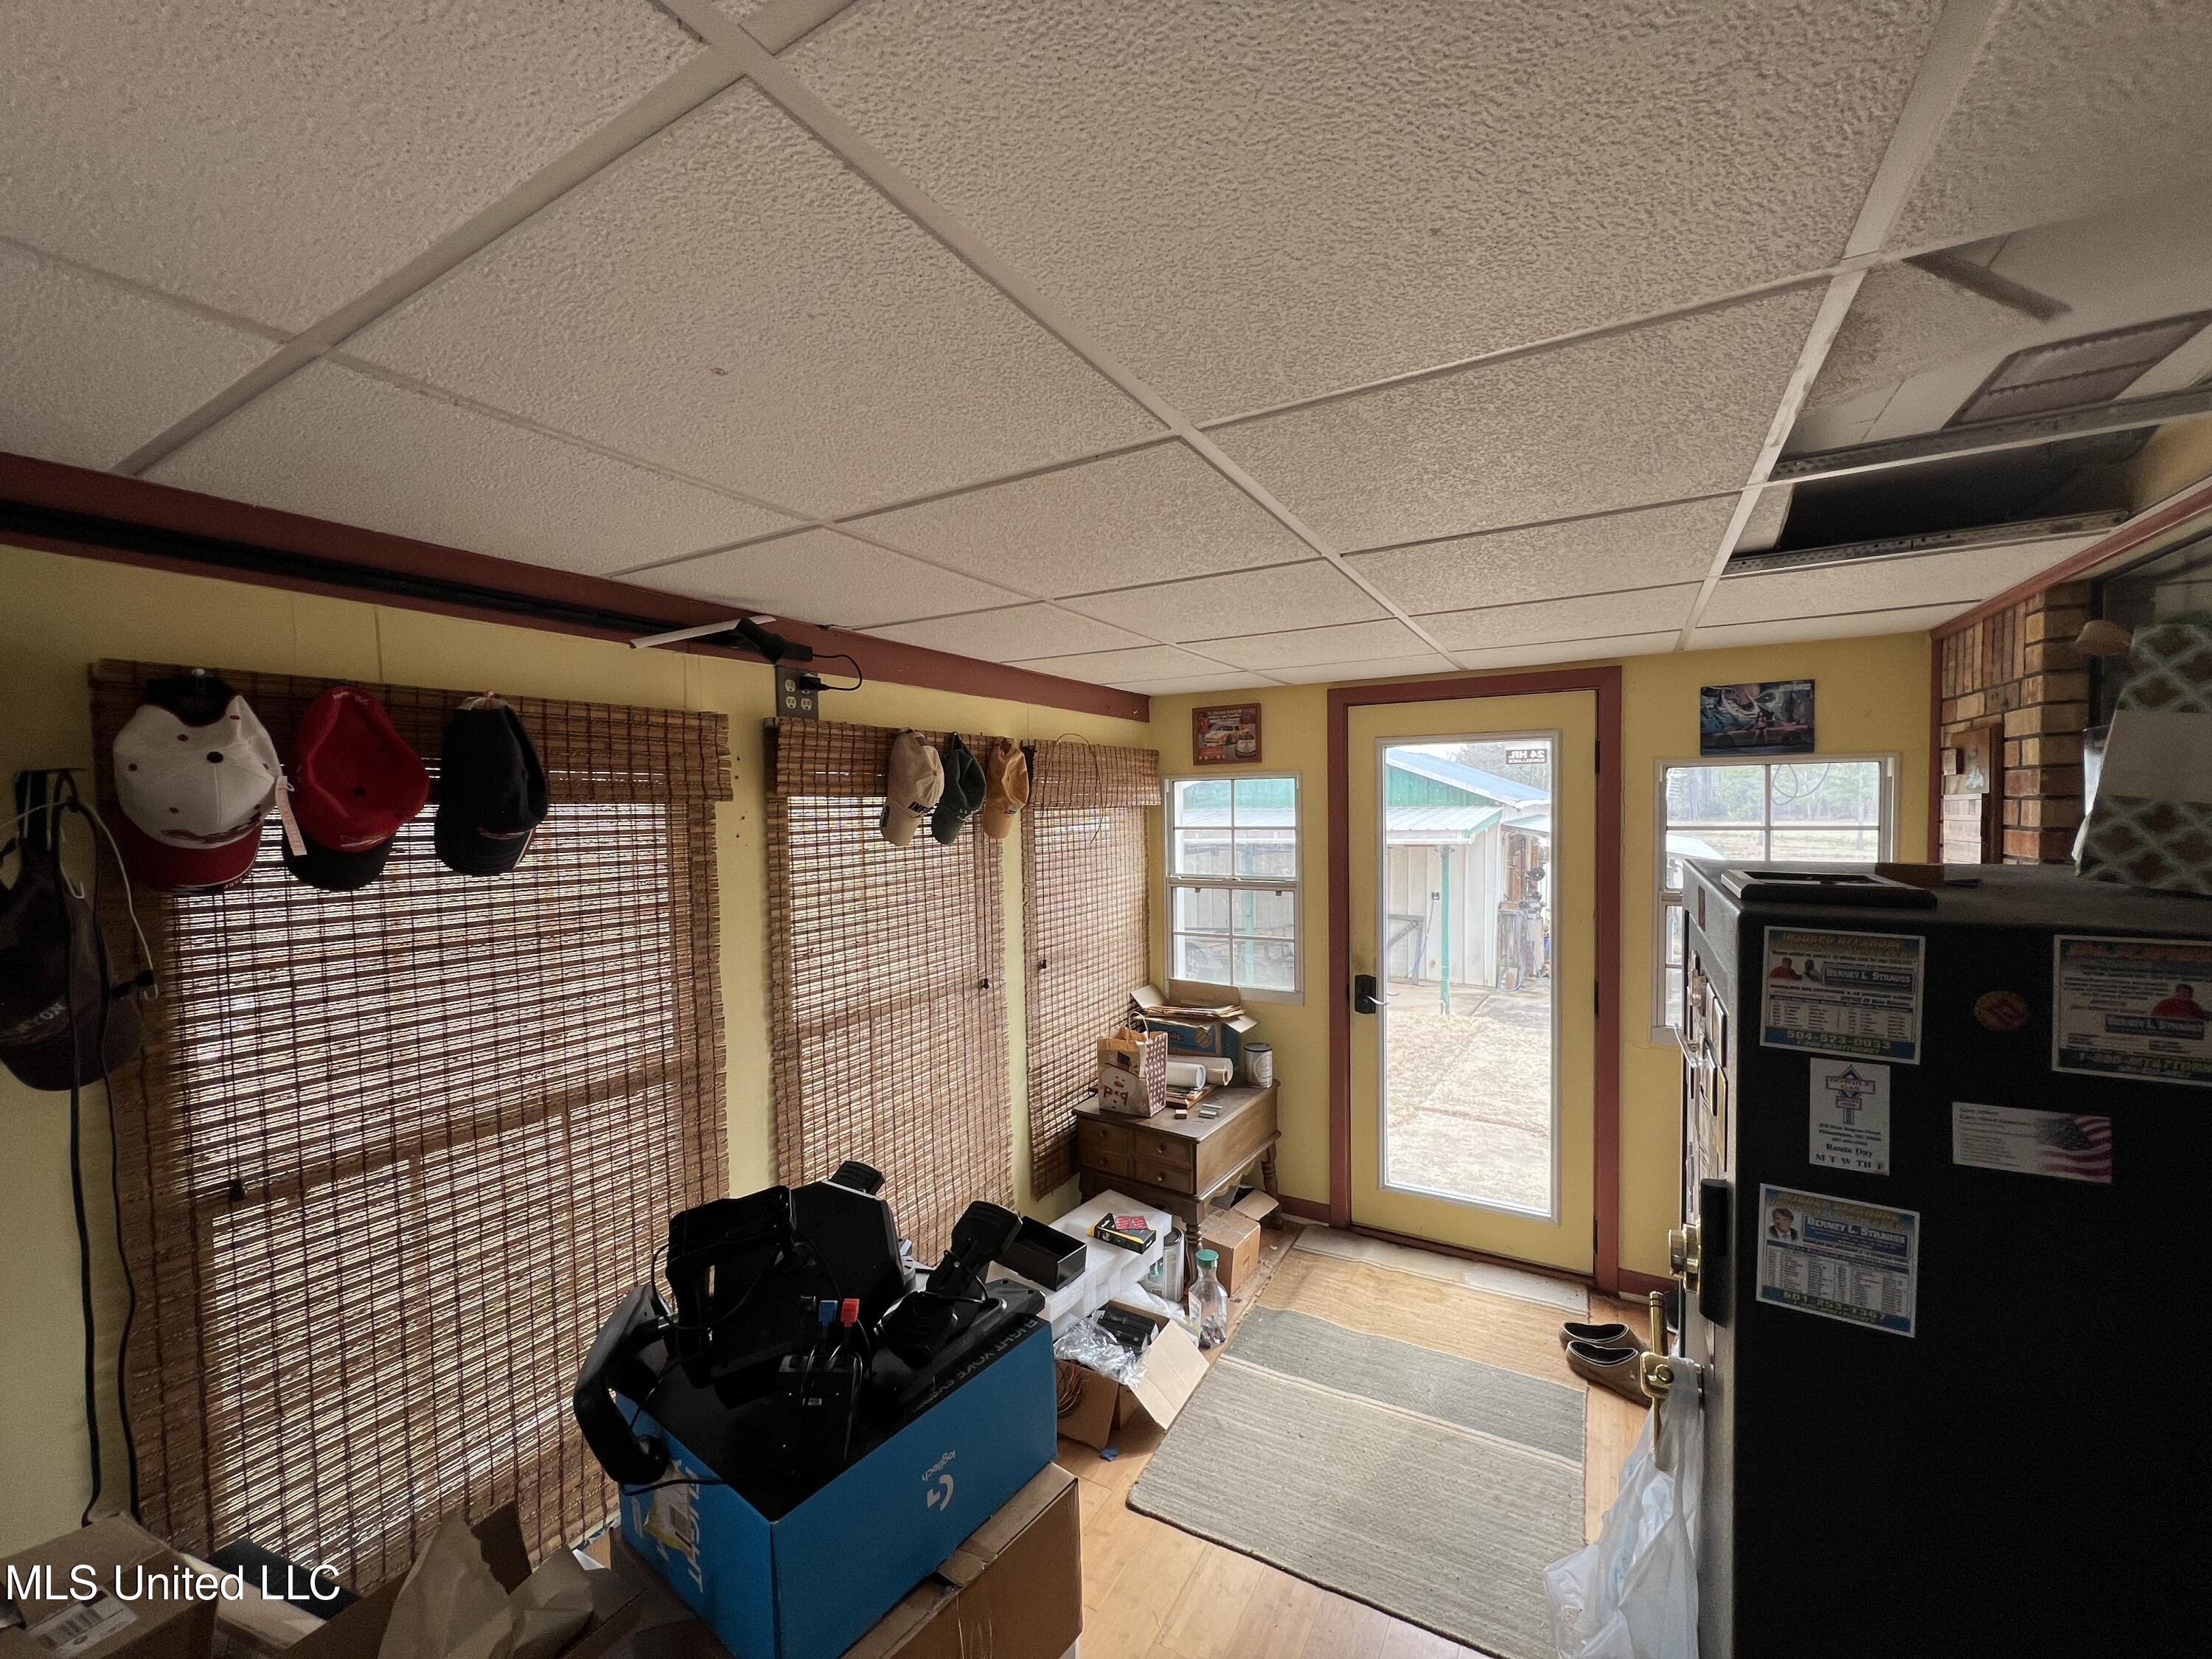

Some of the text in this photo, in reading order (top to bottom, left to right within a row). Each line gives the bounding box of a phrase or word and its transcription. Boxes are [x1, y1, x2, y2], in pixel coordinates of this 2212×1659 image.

[1826, 967, 1860, 980] BERNEY
[1872, 971, 1912, 984] STRAUSS
[1787, 1029, 1891, 1050] 504-523-0033
[1826, 1143, 1874, 1158] Route Day
[1815, 1153, 1826, 1162] M
[1856, 1160, 1871, 1169] TH
[1807, 1217, 1846, 1231] BERNEY
[1860, 1227, 1905, 1244] STRAUSS
